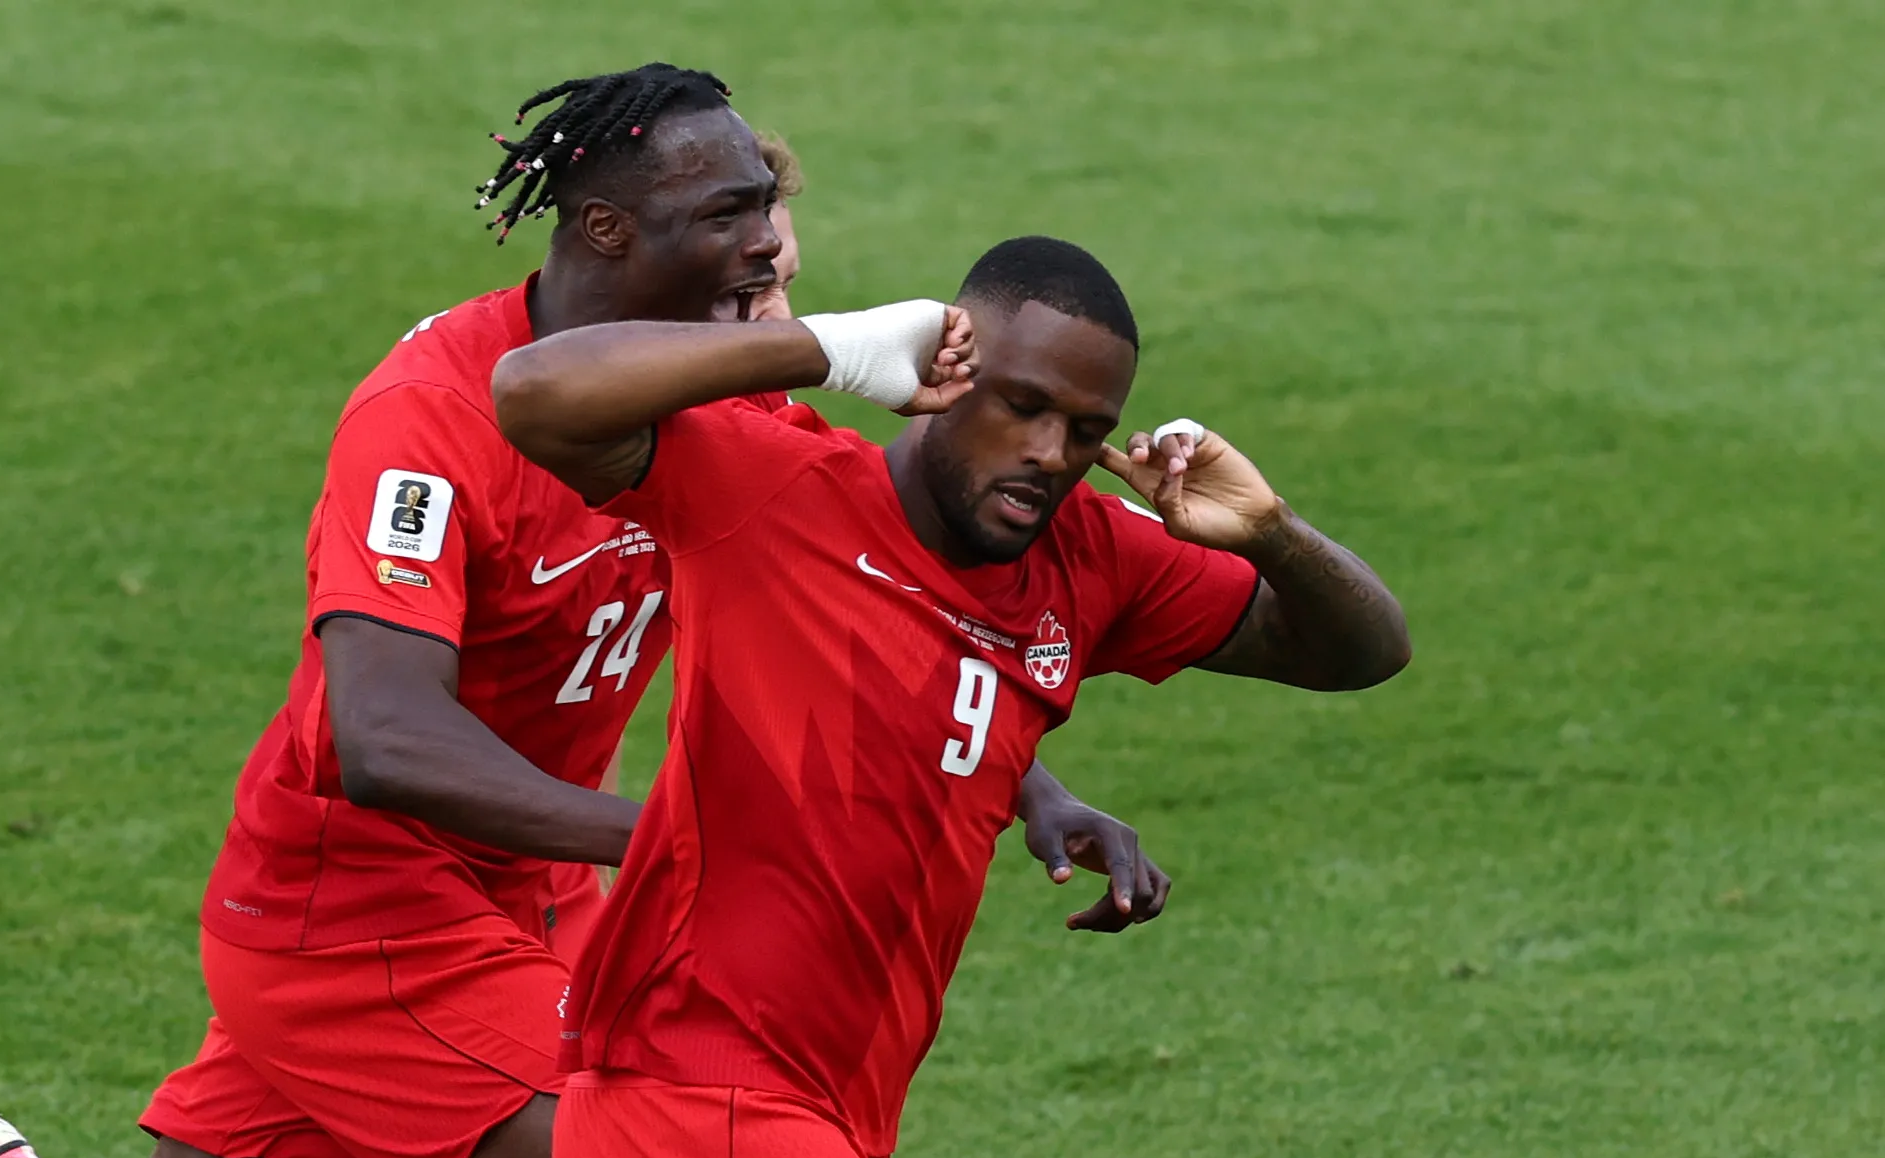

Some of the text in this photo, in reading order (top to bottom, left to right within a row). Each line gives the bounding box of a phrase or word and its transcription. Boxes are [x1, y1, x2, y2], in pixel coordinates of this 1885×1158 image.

[387, 540, 420, 552] 2026
[555, 590, 664, 704] 24
[1027, 646, 1069, 660] CANADA
[940, 656, 998, 777] 9
